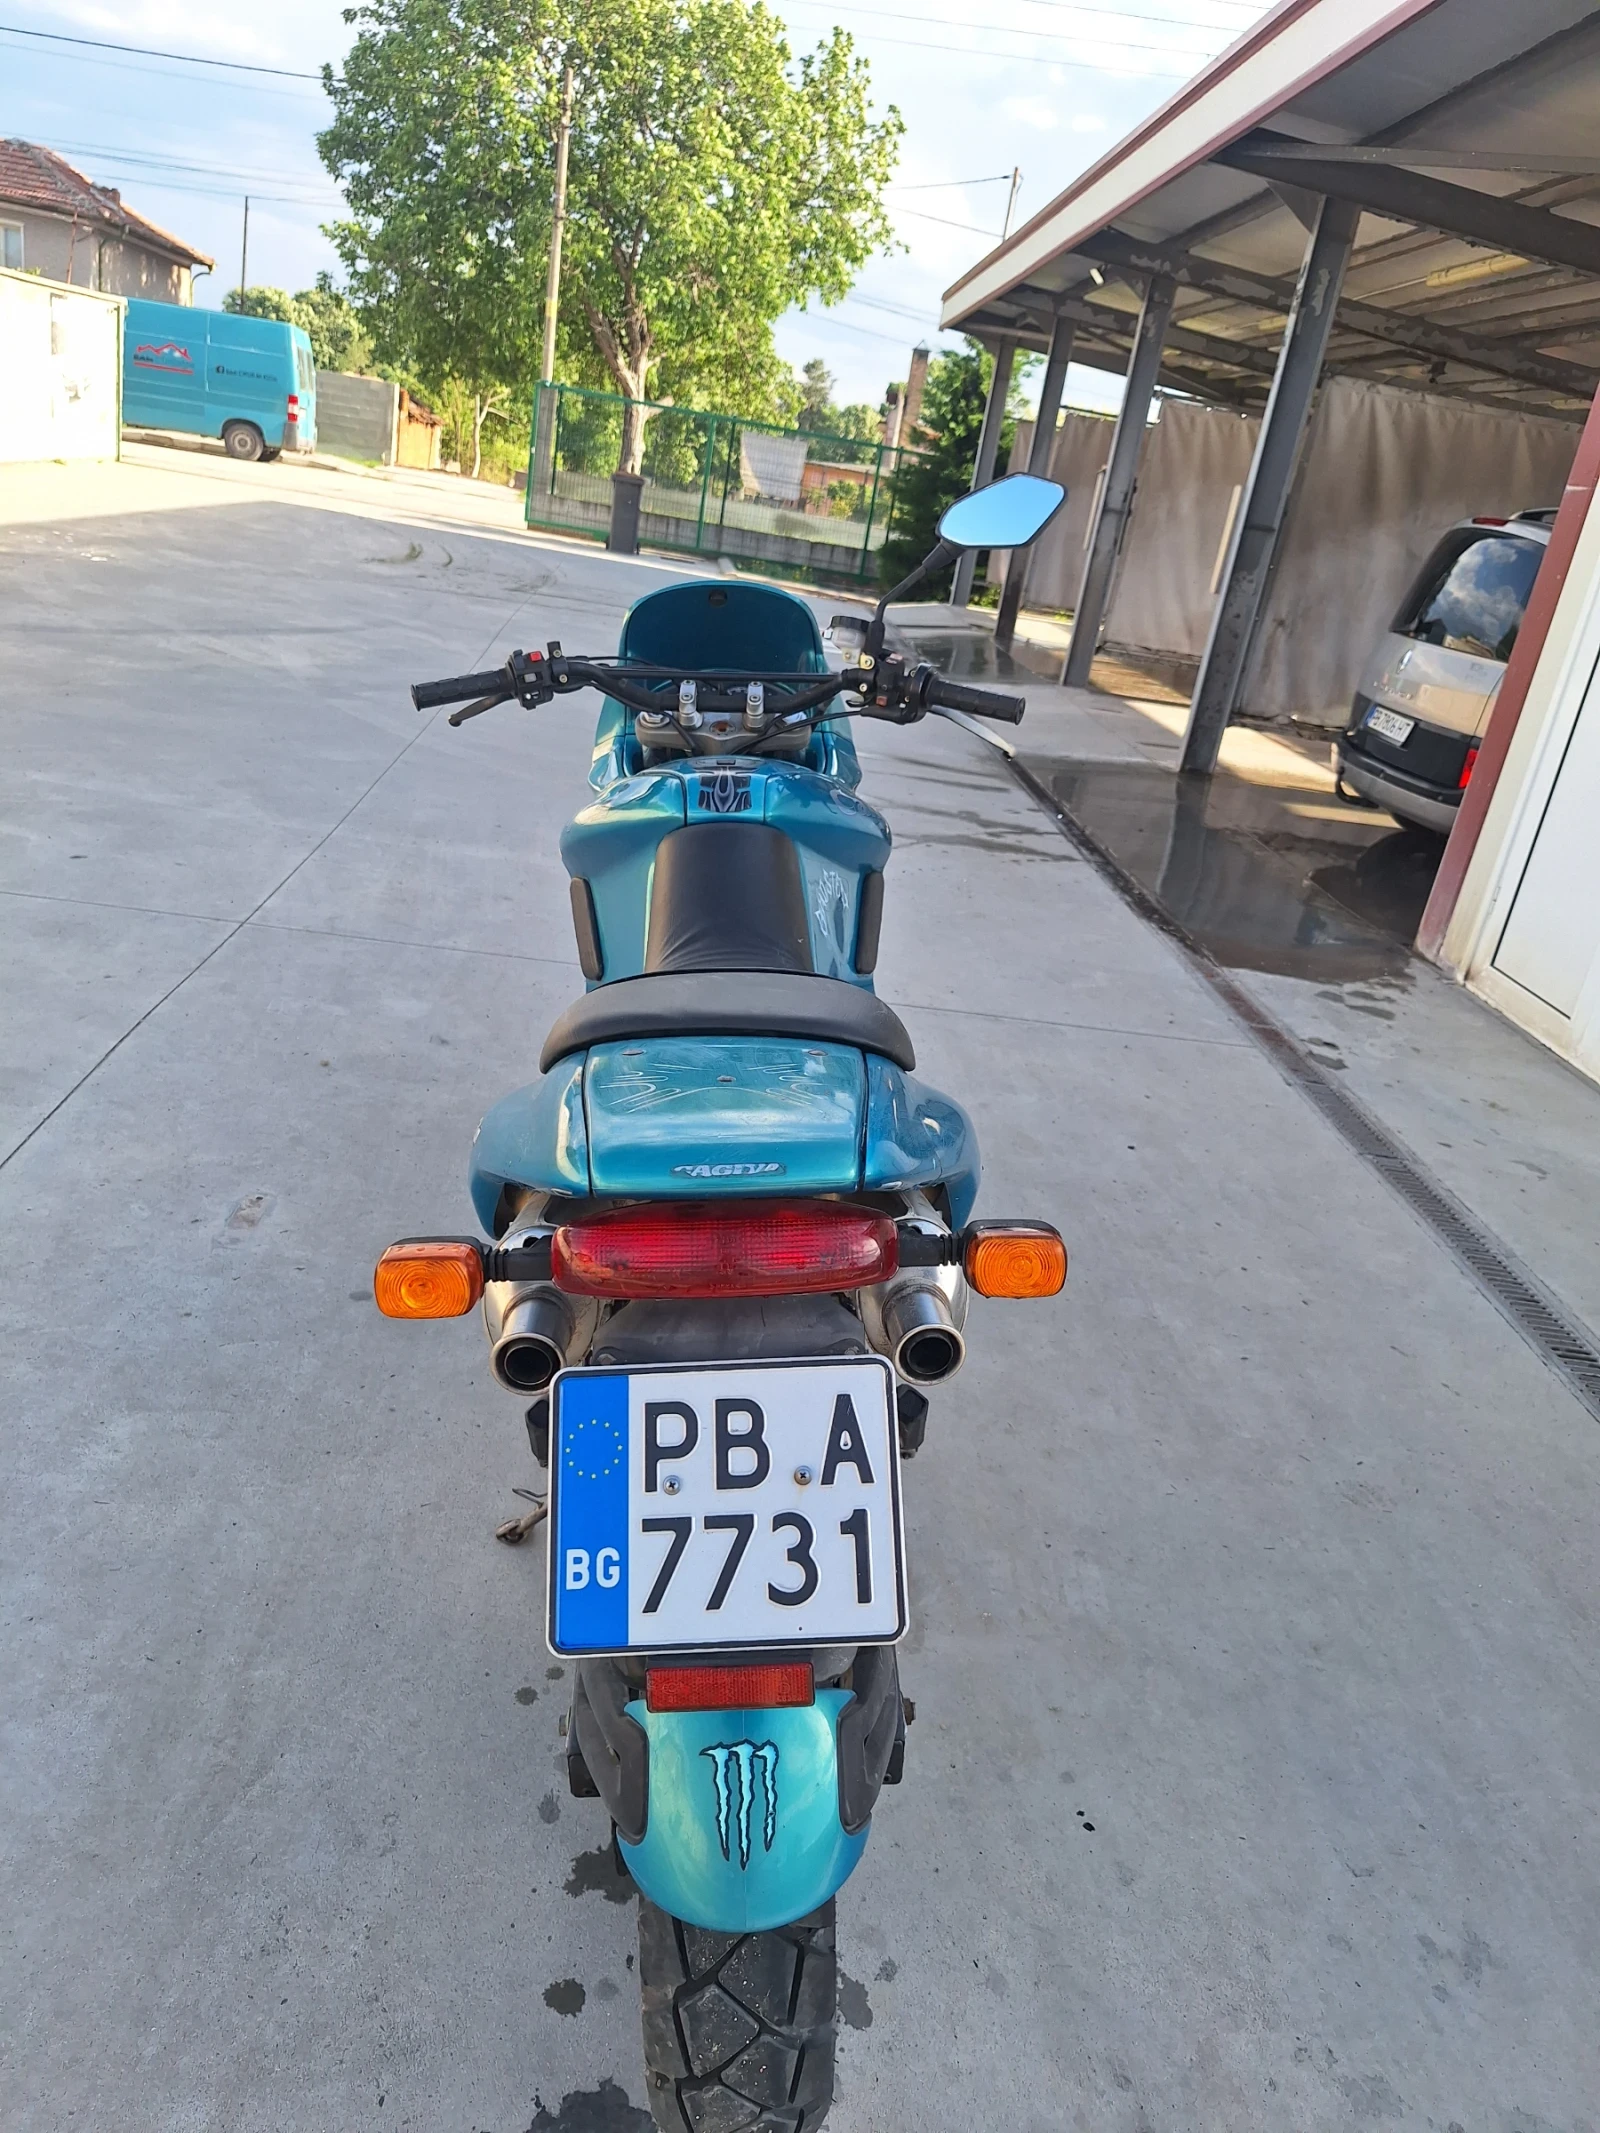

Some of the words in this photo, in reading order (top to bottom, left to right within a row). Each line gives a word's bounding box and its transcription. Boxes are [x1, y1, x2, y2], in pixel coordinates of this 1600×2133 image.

[644, 1398, 771, 1493] PB
[821, 1393, 875, 1486] A
[565, 1547, 621, 1591] BG
[641, 1508, 873, 1615] 7731
